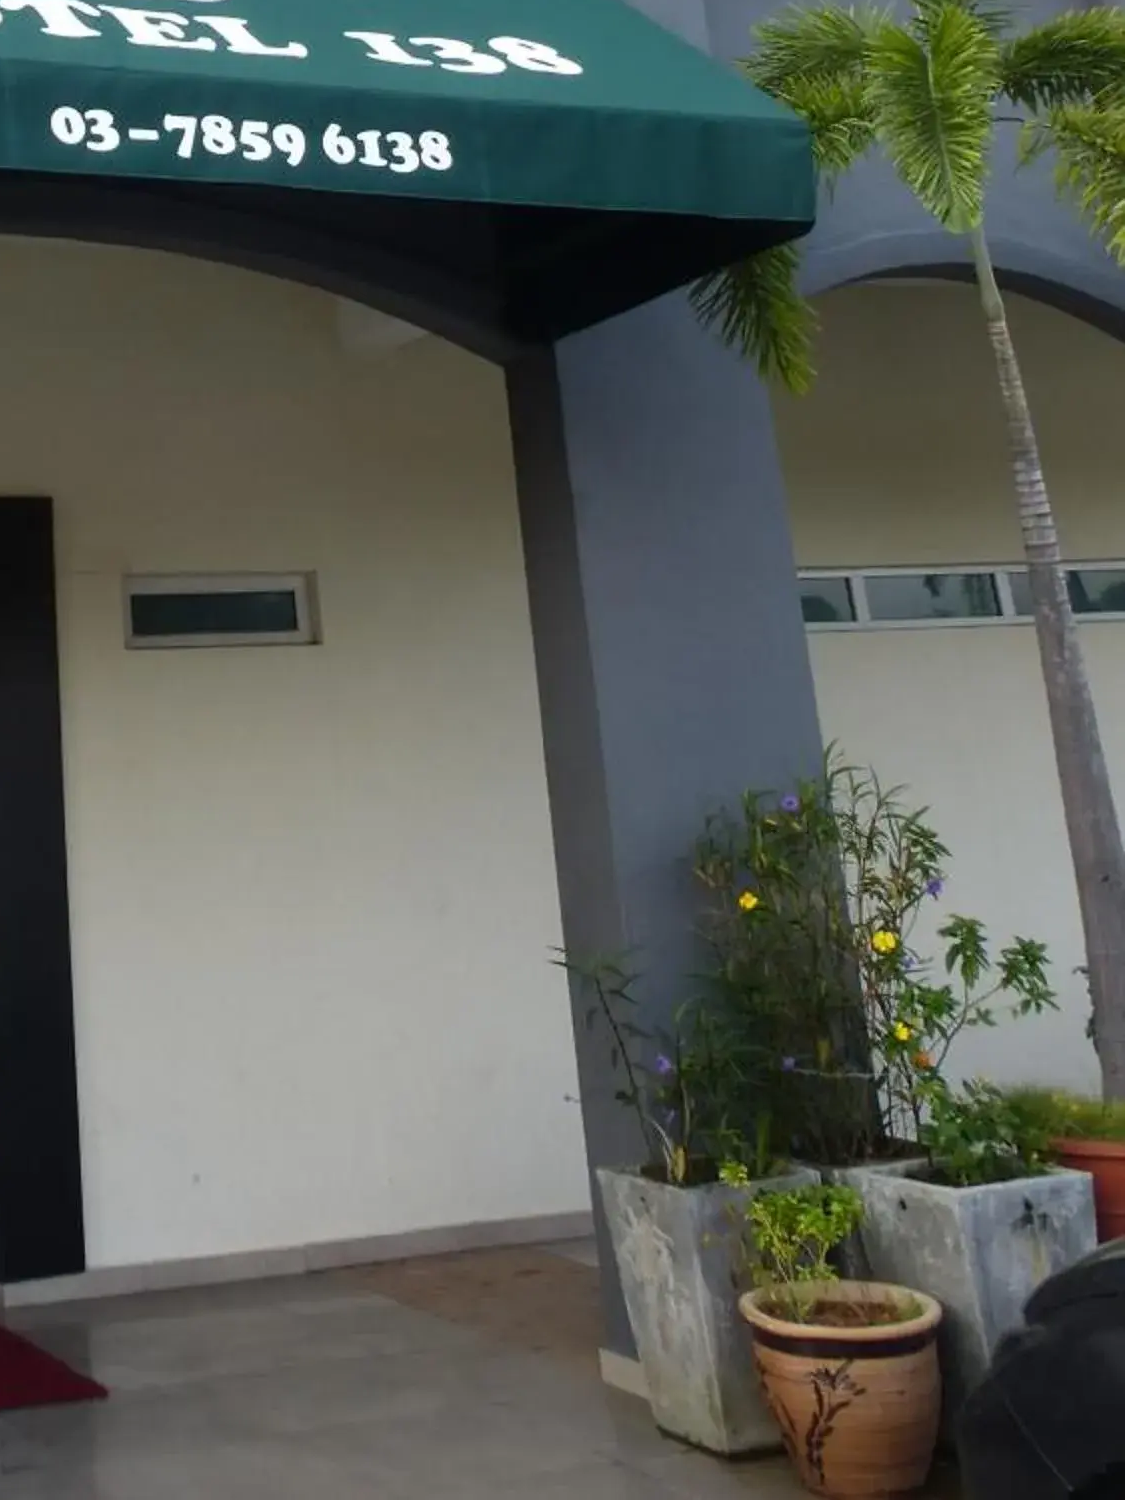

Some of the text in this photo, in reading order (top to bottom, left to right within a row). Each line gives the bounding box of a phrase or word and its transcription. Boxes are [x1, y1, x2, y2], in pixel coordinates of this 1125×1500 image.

[343, 31, 585, 76] 138
[50, 106, 453, 173] 03-7859 6138
